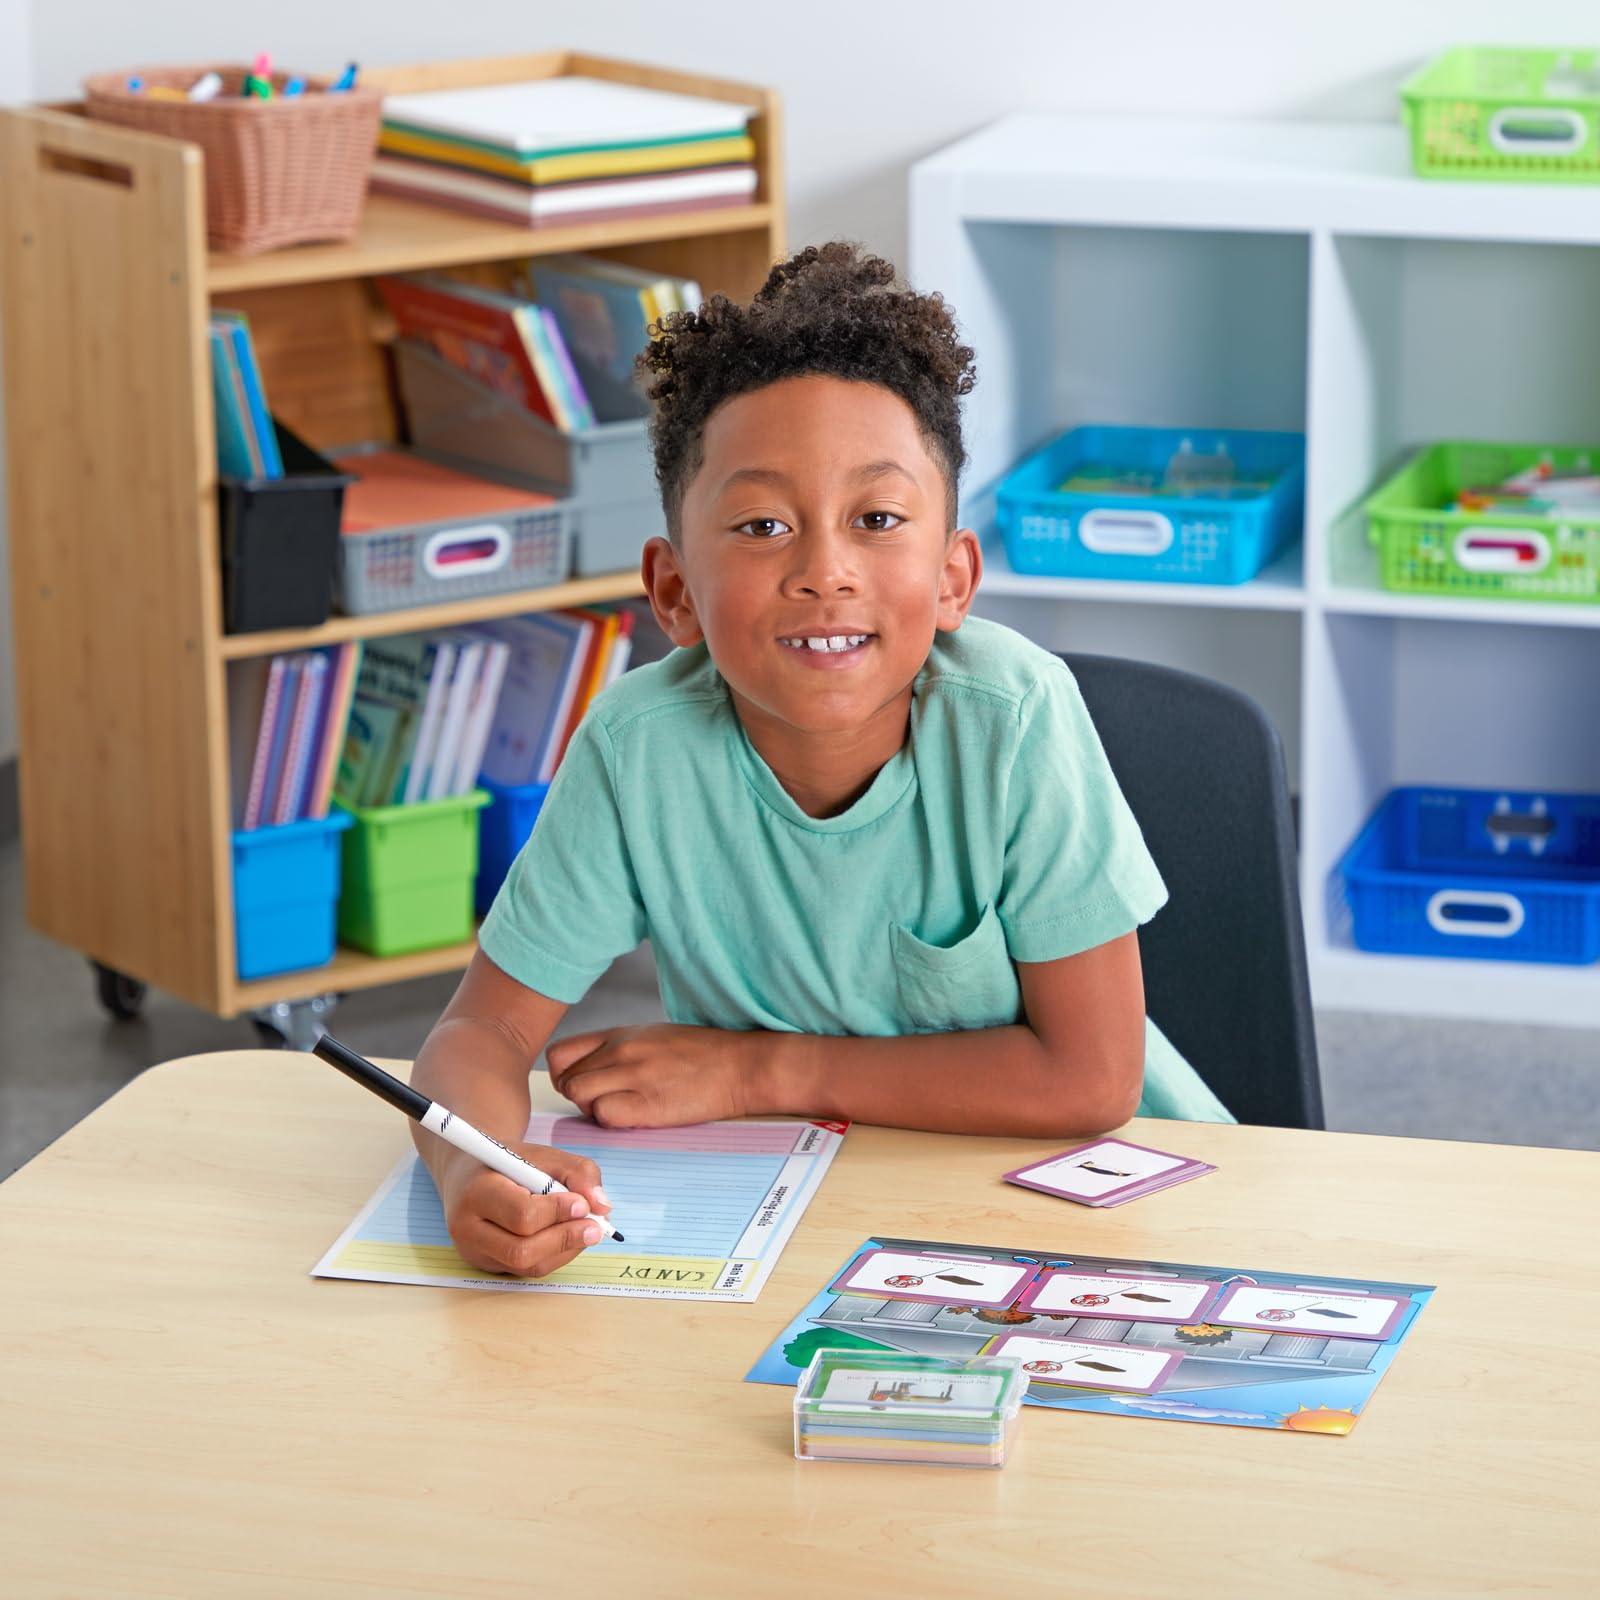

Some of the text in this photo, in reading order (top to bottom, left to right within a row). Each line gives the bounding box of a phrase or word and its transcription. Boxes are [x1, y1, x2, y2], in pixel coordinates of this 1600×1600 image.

[801, 1129, 822, 1152] conclusion
[757, 1186, 789, 1227] supporting details
[619, 1265, 706, 1282] CANDY
[722, 1263, 744, 1288] main idea
